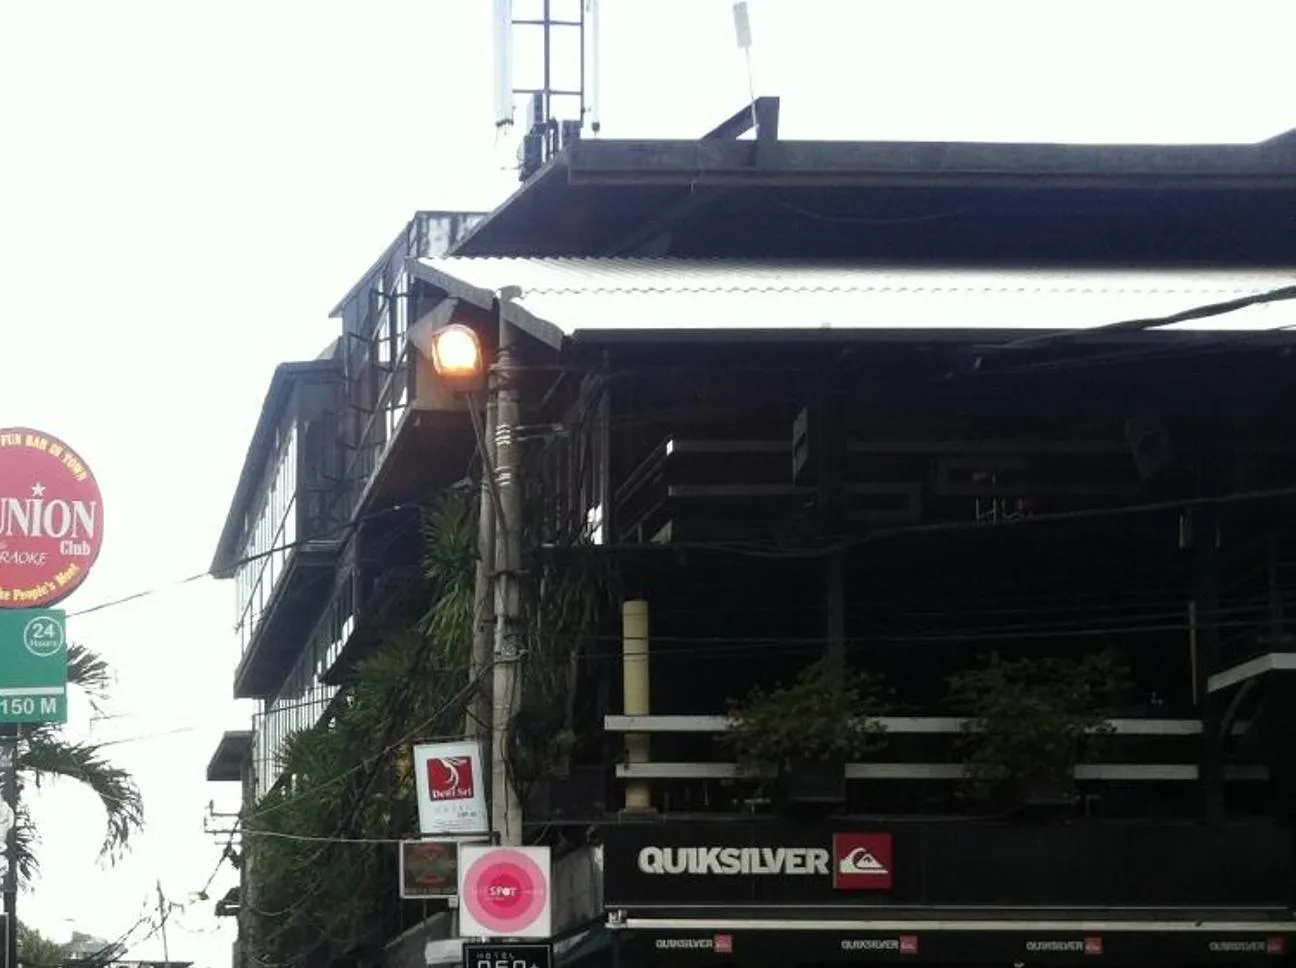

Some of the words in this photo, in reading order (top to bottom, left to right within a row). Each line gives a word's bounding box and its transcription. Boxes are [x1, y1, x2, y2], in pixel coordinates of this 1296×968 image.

[59, 539, 91, 556] Club
[32, 622, 54, 640] 24
[40, 697, 57, 715] M
[637, 845, 831, 876] QUIKSILVER
[488, 885, 518, 897] SPOT
[655, 938, 714, 950] QUIKSILVER
[840, 939, 900, 951] QUIKSILVER
[1025, 940, 1084, 952] QUIKSILVER
